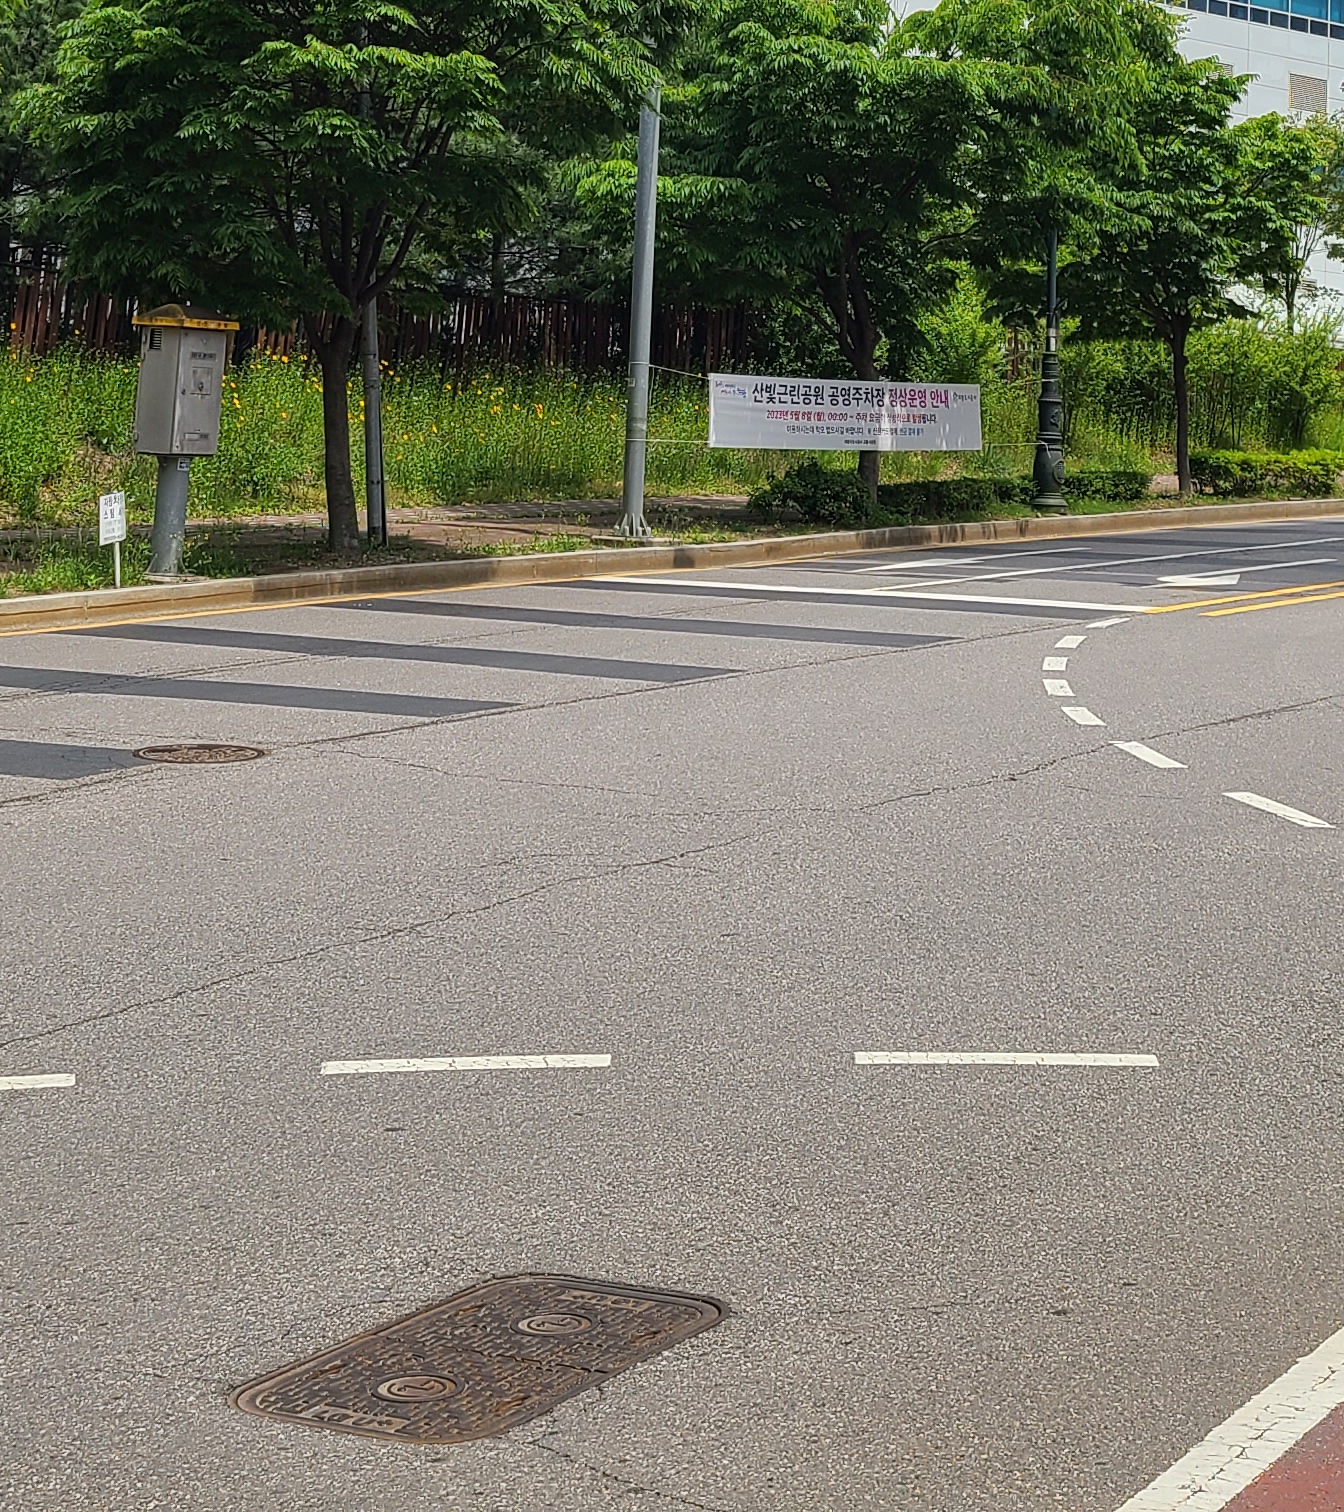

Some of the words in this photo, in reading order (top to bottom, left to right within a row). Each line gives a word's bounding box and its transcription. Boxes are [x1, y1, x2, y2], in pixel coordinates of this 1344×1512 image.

[752, 382, 825, 406] 산빛근린공원
[827, 385, 885, 408] 공영주차장
[888, 388, 927, 408] 정상운영
[929, 389, 949, 409] 안내
